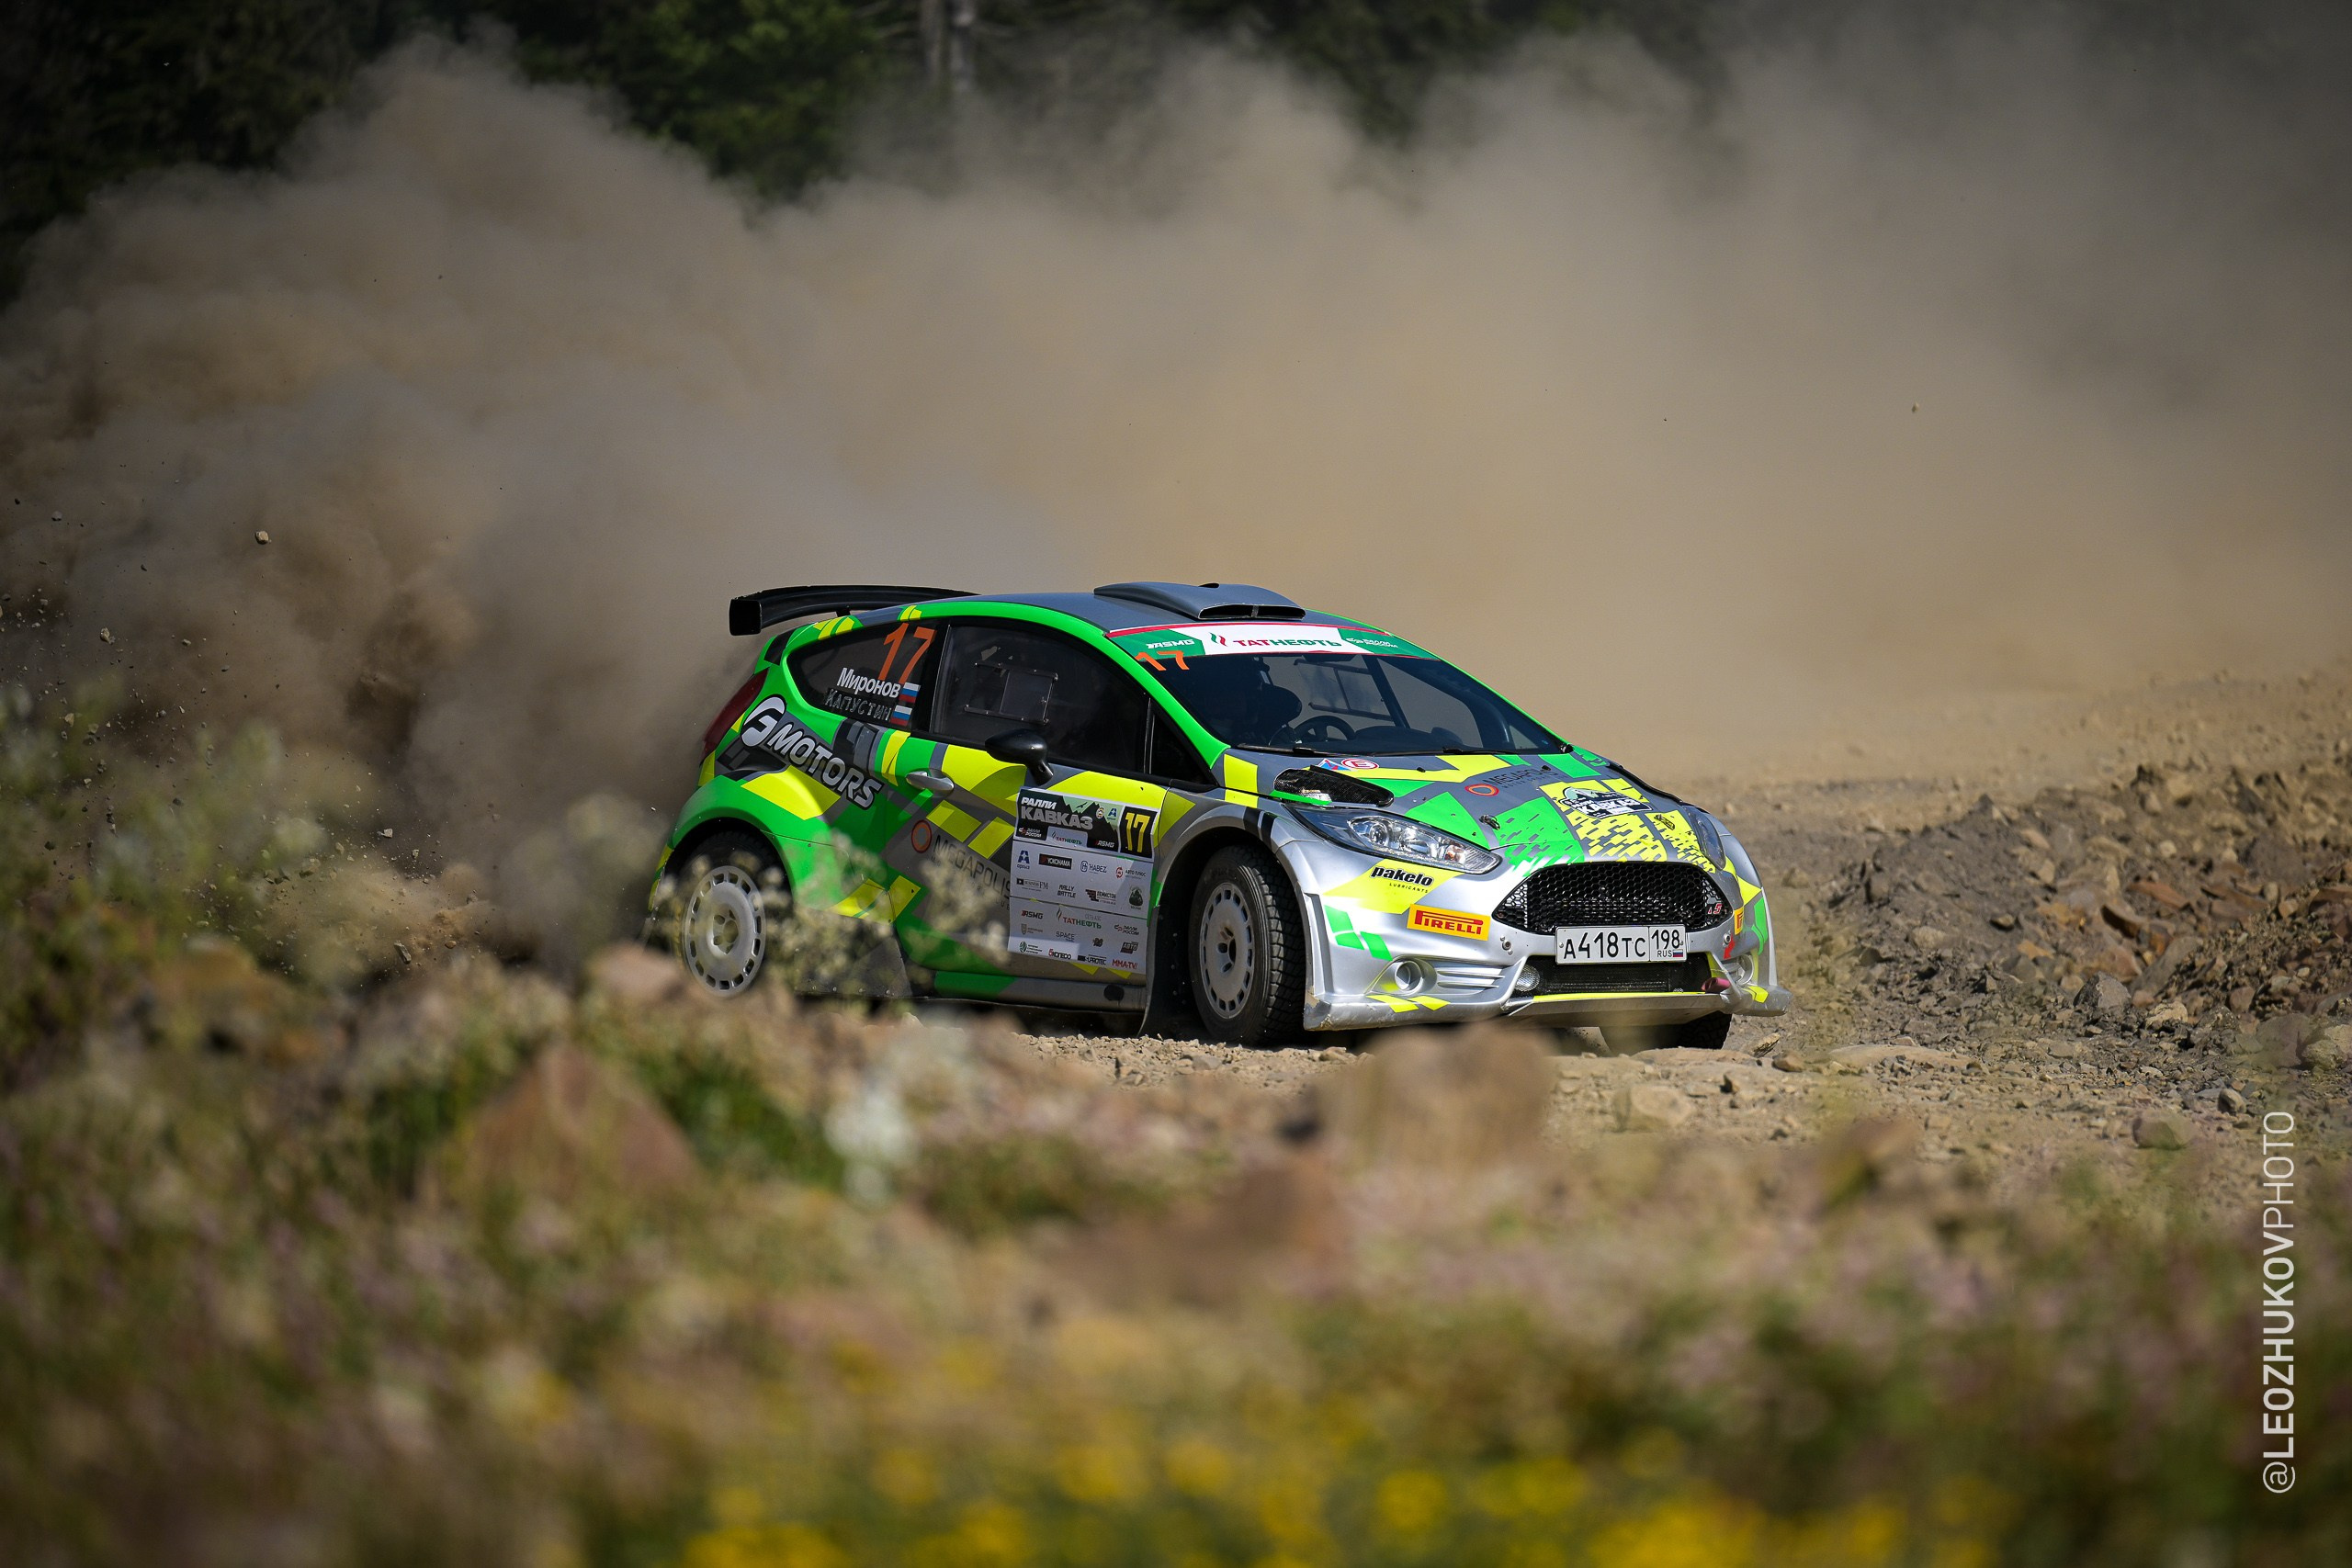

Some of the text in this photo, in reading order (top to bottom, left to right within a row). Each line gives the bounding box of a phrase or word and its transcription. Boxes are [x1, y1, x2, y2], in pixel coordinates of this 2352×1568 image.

[877, 623, 936, 684] 17
[1135, 650, 1190, 671] 17
[836, 668, 901, 698] Миронов
[825, 688, 892, 721] КАПУСТИН
[766, 723, 883, 808] MOTORS
[1021, 796, 1057, 810] РАЛЛИ
[1021, 806, 1093, 830] КАВКАЗ
[1125, 812, 1150, 853] 17
[1047, 857, 1070, 867] YOKOHAMA
[1371, 866, 1433, 886] pakelo
[1389, 882, 1429, 893] LUBRICANTS
[1062, 917, 1102, 929] ТАТНЕФТЬ
[1414, 909, 1484, 935] PIRELLI
[1056, 931, 1075, 941] SPACE
[1563, 929, 1680, 960] А418ТС 198
[1657, 950, 1672, 958] RUS
